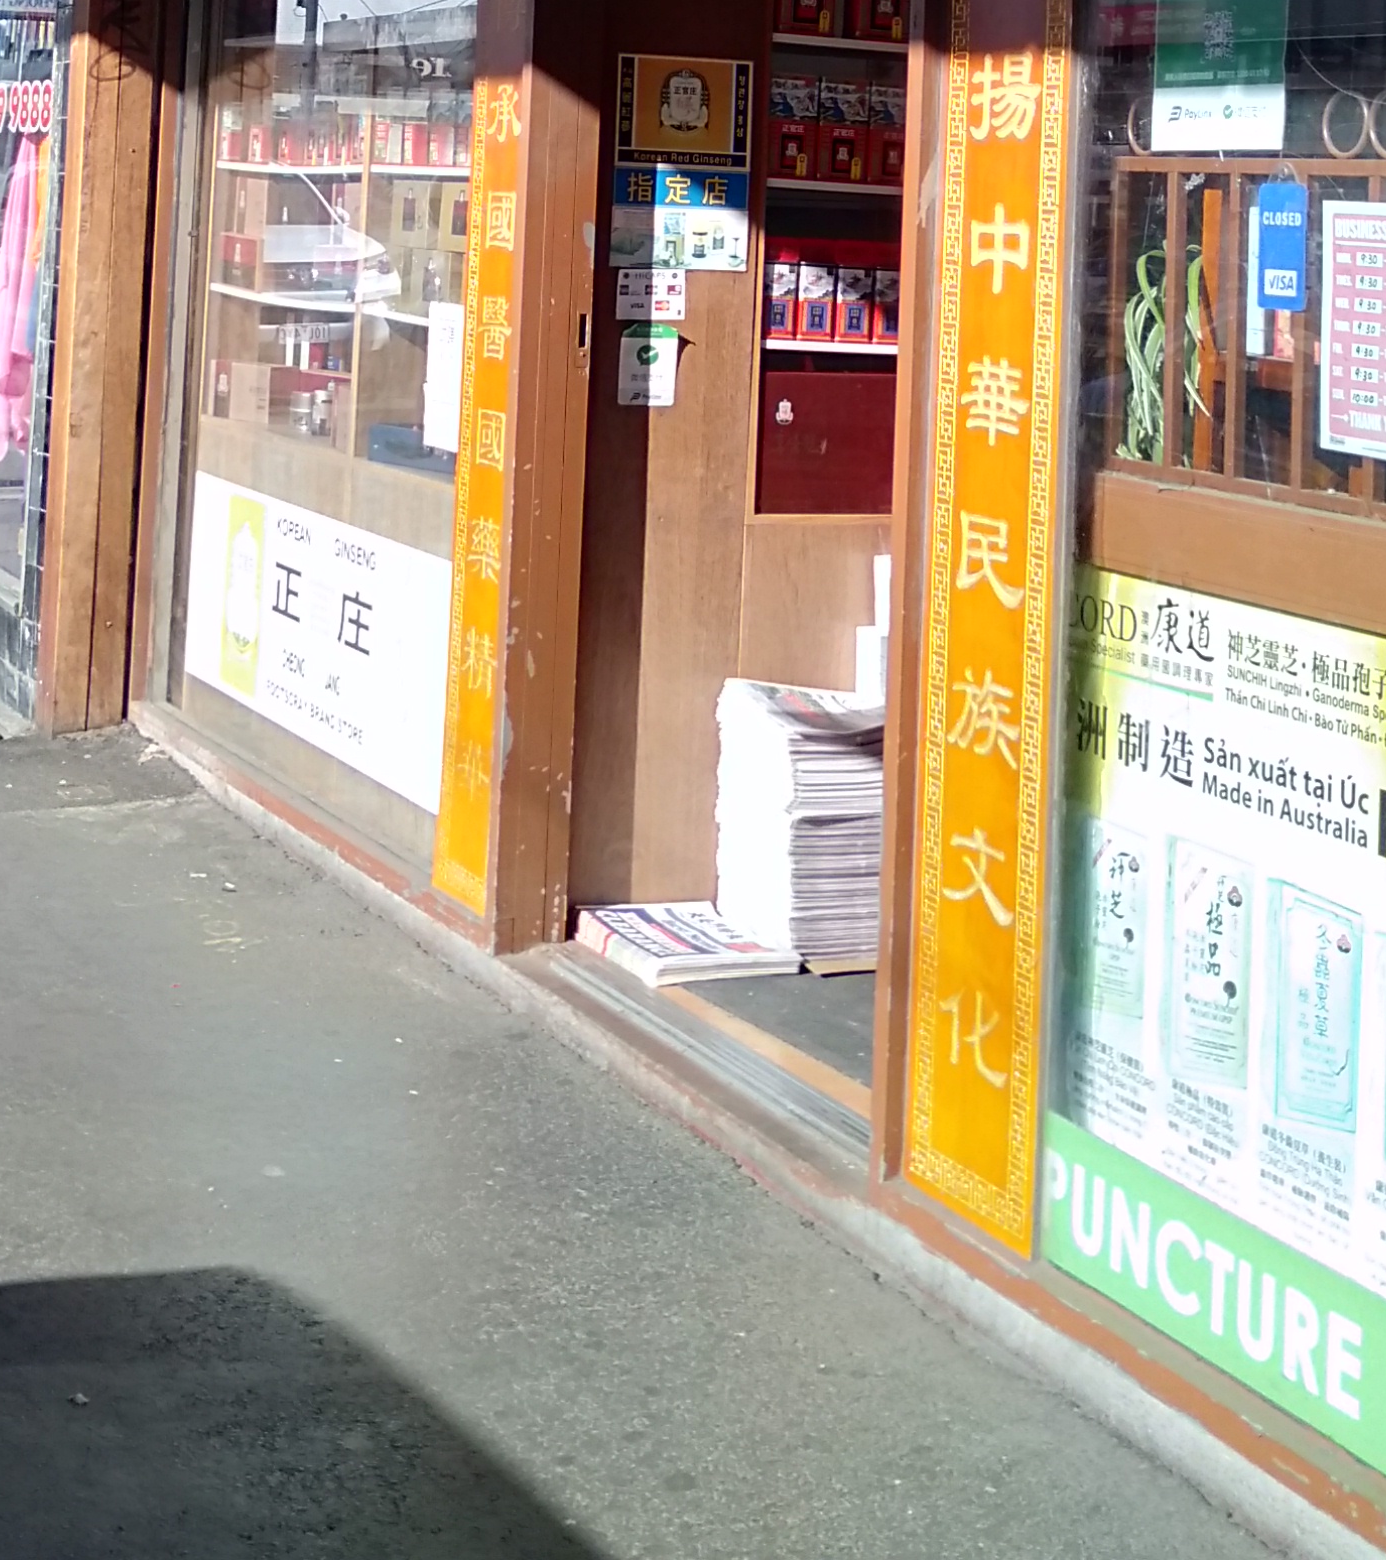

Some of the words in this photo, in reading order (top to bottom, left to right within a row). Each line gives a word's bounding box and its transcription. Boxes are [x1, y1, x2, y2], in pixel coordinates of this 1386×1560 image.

[8, 79, 54, 133] 9888
[633, 151, 669, 163] Korean
[670, 152, 690, 164] Red
[692, 153, 733, 167] Ginseng
[626, 171, 729, 207] 指定店
[1263, 211, 1302, 226] CLOSED
[1268, 275, 1295, 291] VISA
[1348, 410, 1382, 432] THANK
[277, 517, 312, 546] KOREAN
[333, 537, 377, 572] GINSENG
[1149, 597, 1215, 663] 康道
[1227, 664, 1267, 688] SUNCHIH
[1269, 675, 1302, 698] Lingzhi
[1311, 686, 1370, 717] Ganoderma
[1250, 693, 1266, 711] Chi
[1268, 698, 1290, 719] Linh
[1291, 704, 1308, 724] Chi
[1203, 735, 1242, 773] Sản
[1247, 756, 1298, 792] xuất
[1303, 769, 1333, 809] tại
[1340, 774, 1370, 816] Úc
[1202, 771, 1252, 809] Made
[1257, 789, 1274, 817] in
[1279, 797, 1369, 849] Australia
